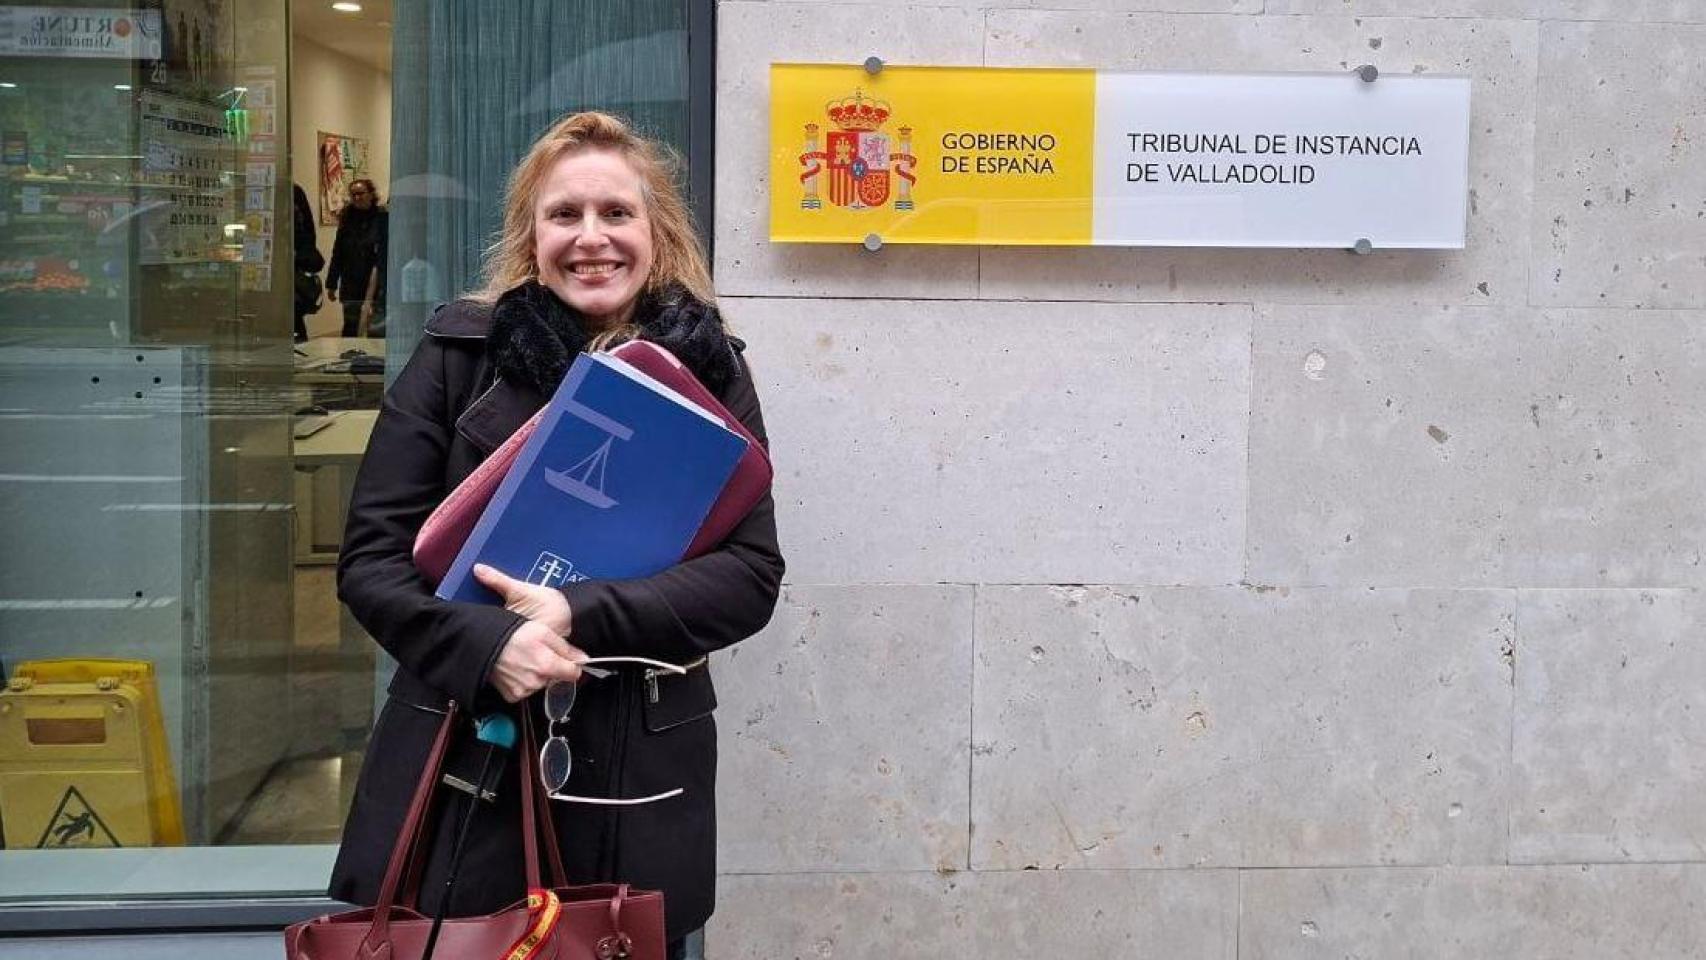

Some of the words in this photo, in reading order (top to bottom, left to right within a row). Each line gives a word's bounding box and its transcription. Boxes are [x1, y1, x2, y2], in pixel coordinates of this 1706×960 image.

[942, 132, 1056, 151] GOBIERNO
[1126, 132, 1248, 154] TRIBUNAL
[1254, 134, 1288, 154] DE
[1296, 135, 1423, 156] INSTANCIA
[942, 156, 970, 173] DE
[976, 152, 1055, 174] ESPAÑA
[1126, 163, 1159, 182] DE
[1166, 163, 1316, 184] VALLADOLID
